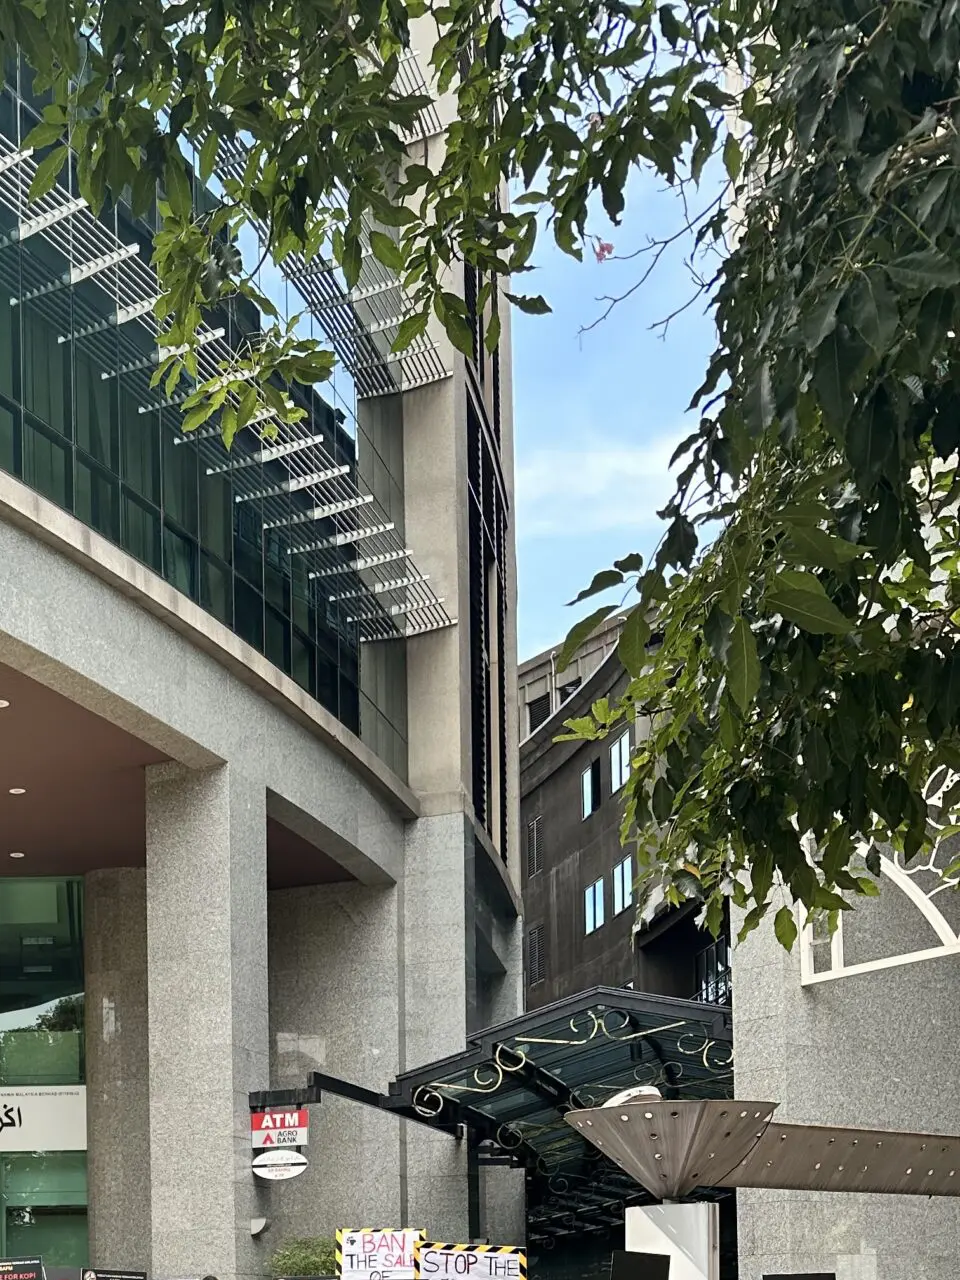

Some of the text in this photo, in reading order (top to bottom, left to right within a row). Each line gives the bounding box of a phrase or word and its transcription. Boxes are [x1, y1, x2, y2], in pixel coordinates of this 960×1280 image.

[261, 1112, 299, 1129] ATM
[362, 1233, 406, 1253] BAN
[345, 1253, 415, 1270] THE SALE
[423, 1250, 520, 1277] STOP THE
[19, 1272, 37, 1280] KOPI
